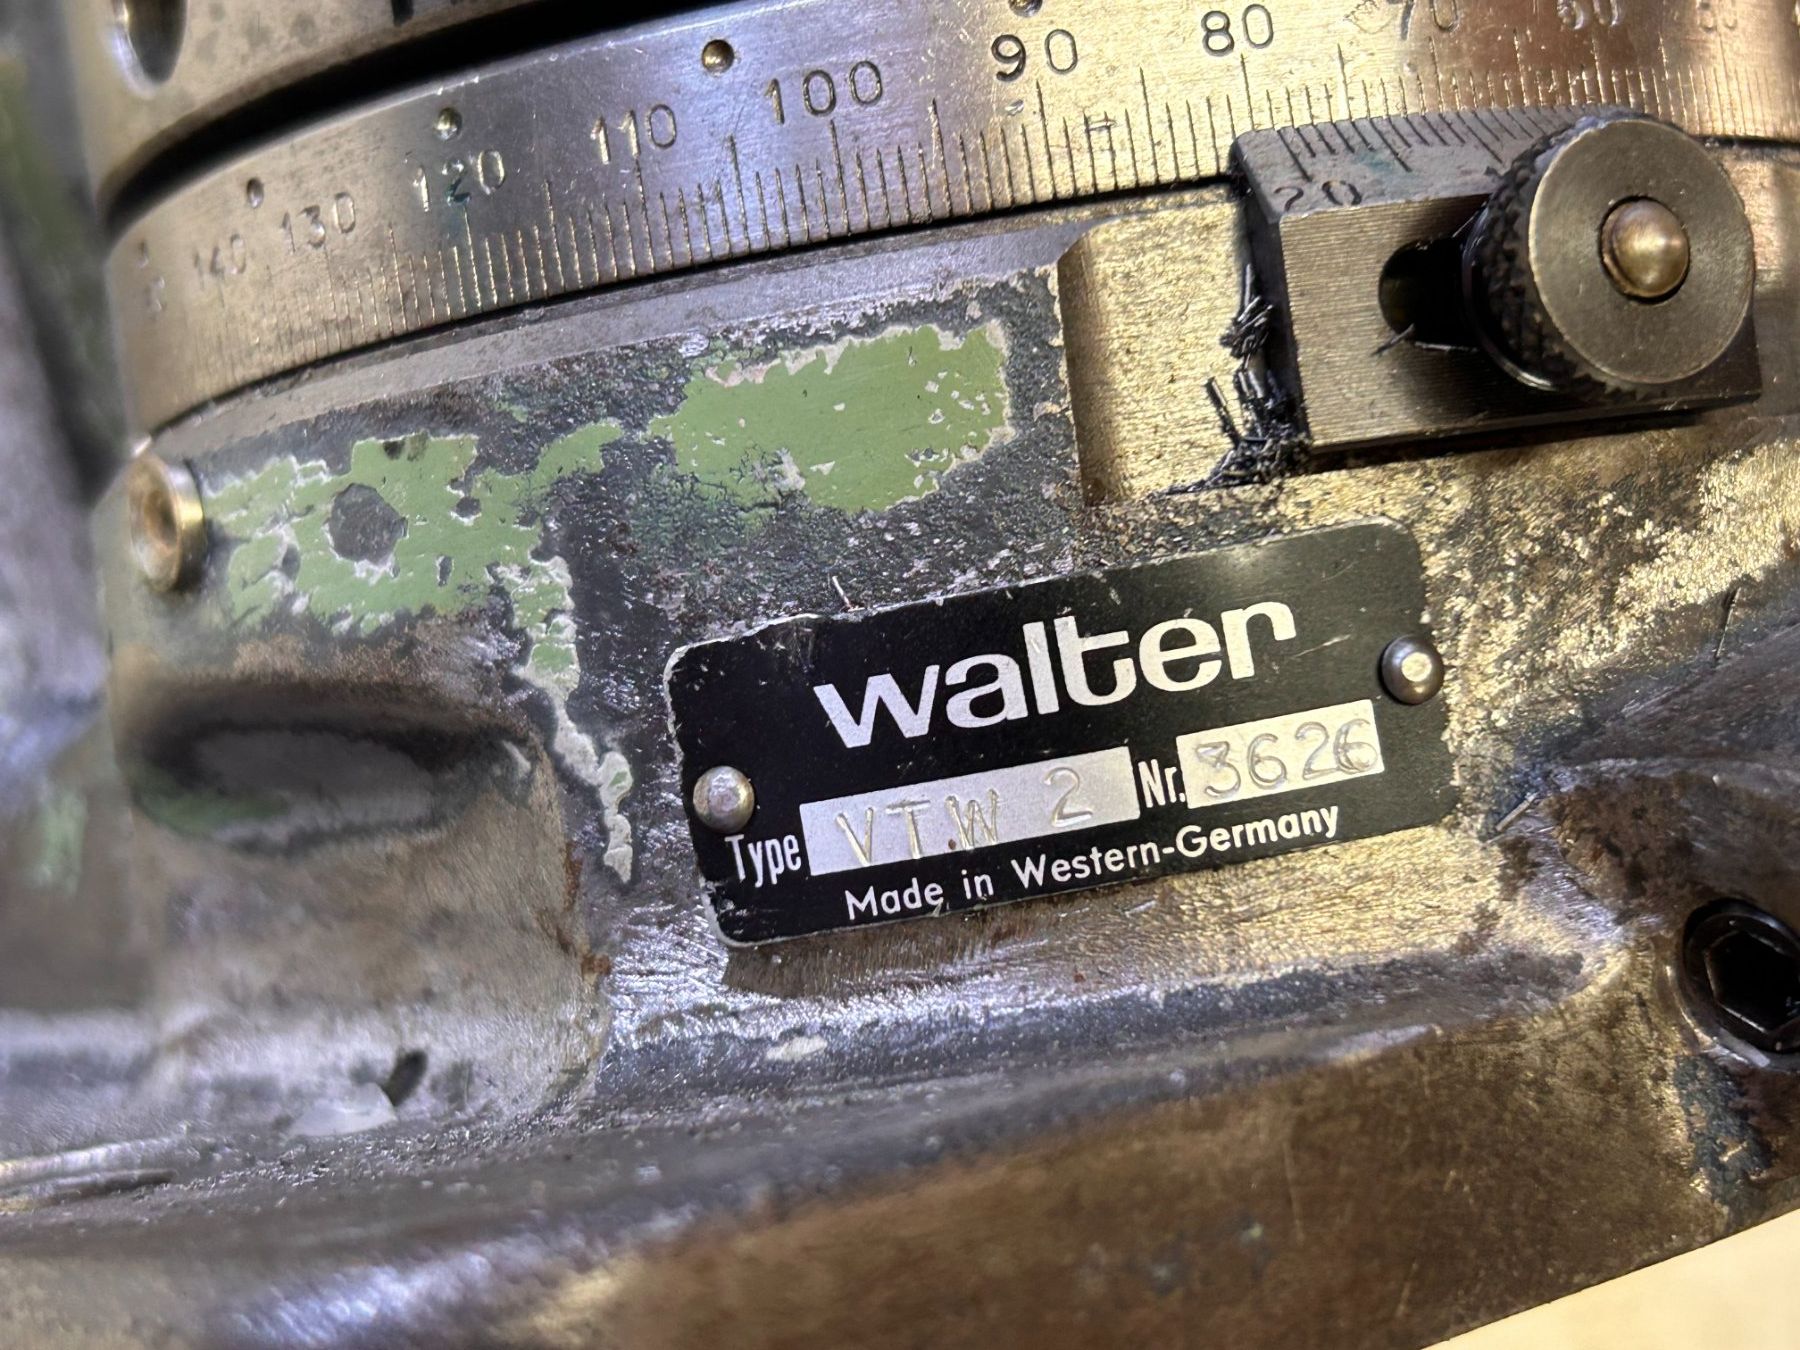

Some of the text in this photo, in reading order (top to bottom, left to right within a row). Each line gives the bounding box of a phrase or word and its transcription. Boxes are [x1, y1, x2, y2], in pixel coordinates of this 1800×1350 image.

[281, 191, 356, 256] 130
[412, 150, 505, 213] 120
[591, 104, 677, 164] 110
[765, 60, 883, 125] 100
[991, 28, 1079, 82] 90
[1201, 3, 1274, 57] 80
[814, 601, 1296, 749] walter
[725, 833, 802, 888] Type
[1043, 766, 1093, 828] 2
[1138, 758, 1186, 808] Nr.
[1196, 718, 1377, 799] 3626
[845, 805, 1339, 921] Made in Western-Germany
